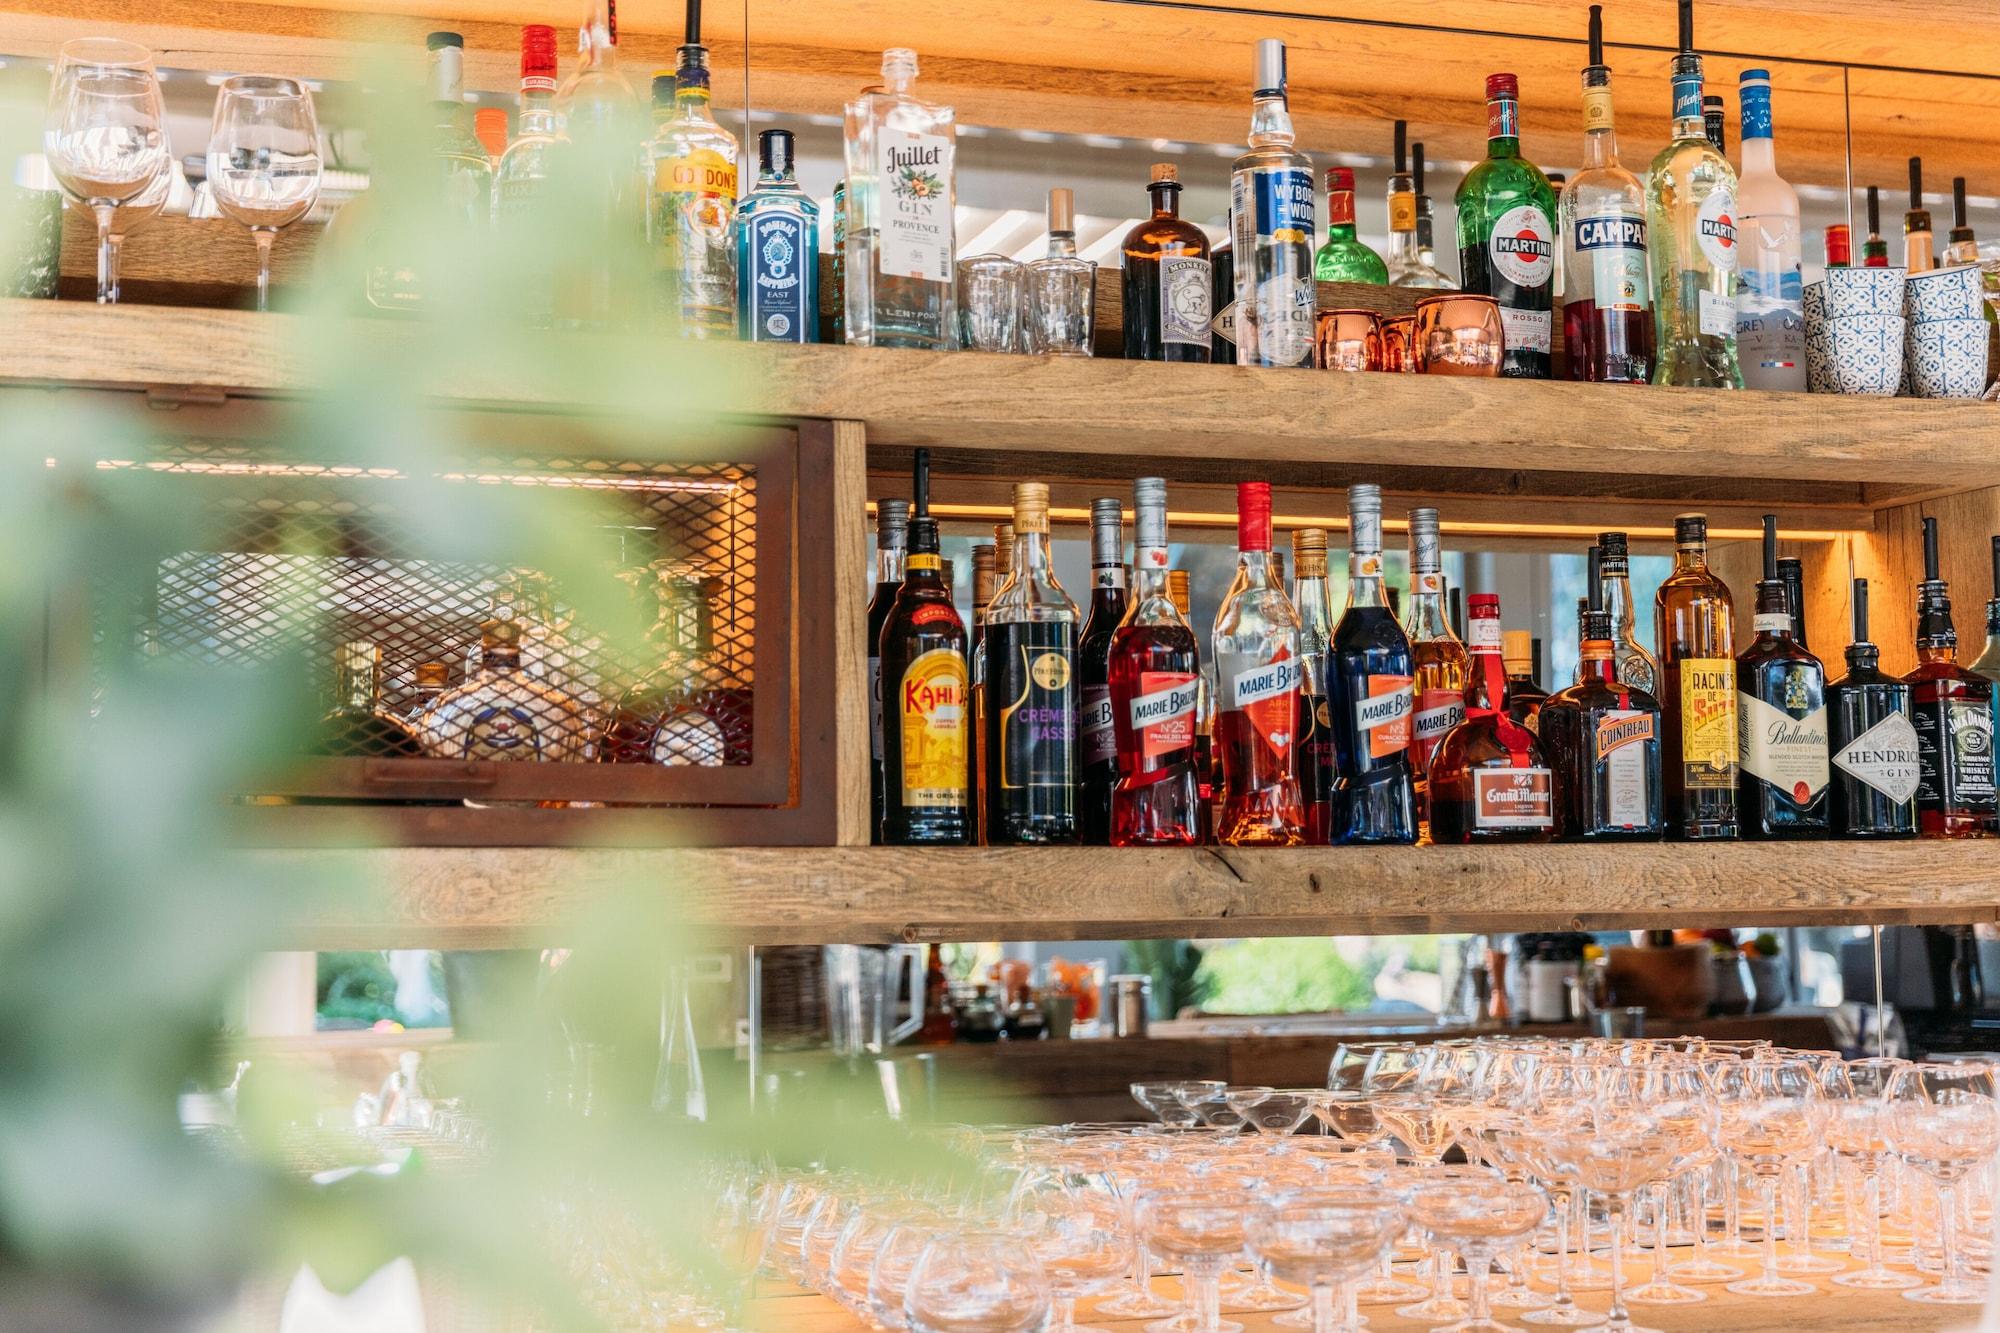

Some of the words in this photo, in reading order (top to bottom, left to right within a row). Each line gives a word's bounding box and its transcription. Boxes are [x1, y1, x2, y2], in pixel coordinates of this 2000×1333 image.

[886, 145, 942, 174] Juillet
[673, 165, 736, 191] GODON'S
[898, 200, 933, 216] GIN
[758, 220, 797, 238] BOMBAY
[893, 219, 940, 234] PROVENCE
[1498, 238, 1550, 256] MARTINI
[1168, 261, 1209, 276] MONKEY
[757, 272, 799, 290] SAPPHIRE
[766, 291, 791, 299] EAST
[1512, 313, 1543, 323] ROSSO
[1754, 334, 1798, 344] VKA
[1239, 672, 1275, 697] MARIE
[1707, 691, 1717, 702] DE
[1135, 698, 1169, 720] MARIE
[1361, 700, 1394, 722] MARIE
[1416, 713, 1448, 734] MARIE
[1948, 715, 1970, 735] JACK
[1029, 727, 1077, 741] CASSS
[1600, 719, 1650, 752] COINTREAU
[1767, 720, 1829, 746] Ballantine's
[1887, 768, 1911, 778] GIN
[1960, 766, 1990, 775] WHISKEY
[1486, 787, 1518, 804] Grand
[1518, 787, 1550, 803] Marnier
